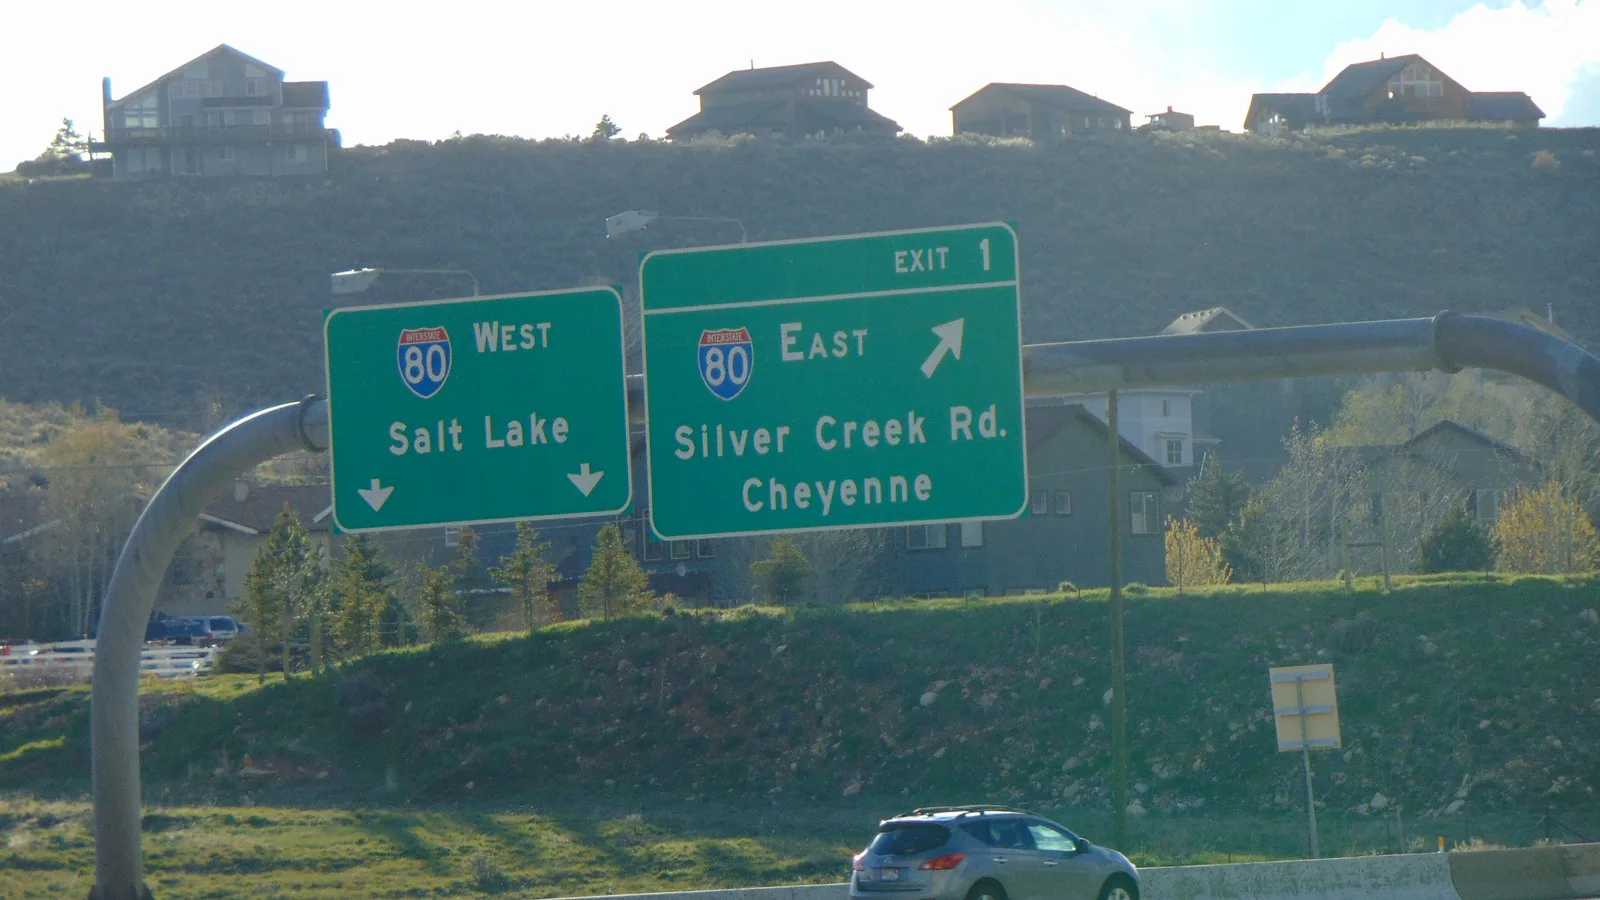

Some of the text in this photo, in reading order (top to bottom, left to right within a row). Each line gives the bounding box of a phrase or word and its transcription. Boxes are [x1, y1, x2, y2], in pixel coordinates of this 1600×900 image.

[895, 238, 991, 273] EXIT 1
[406, 330, 441, 341] INTERSTATE
[473, 321, 551, 353] WEST
[707, 331, 744, 343] INTERSTATE
[780, 322, 867, 361] EAST
[405, 344, 446, 384] 80
[705, 346, 748, 386] 80
[389, 412, 569, 455] Salt Lake
[675, 403, 1007, 459] Silver Creek Rd.
[742, 473, 932, 515] Cheyenne
